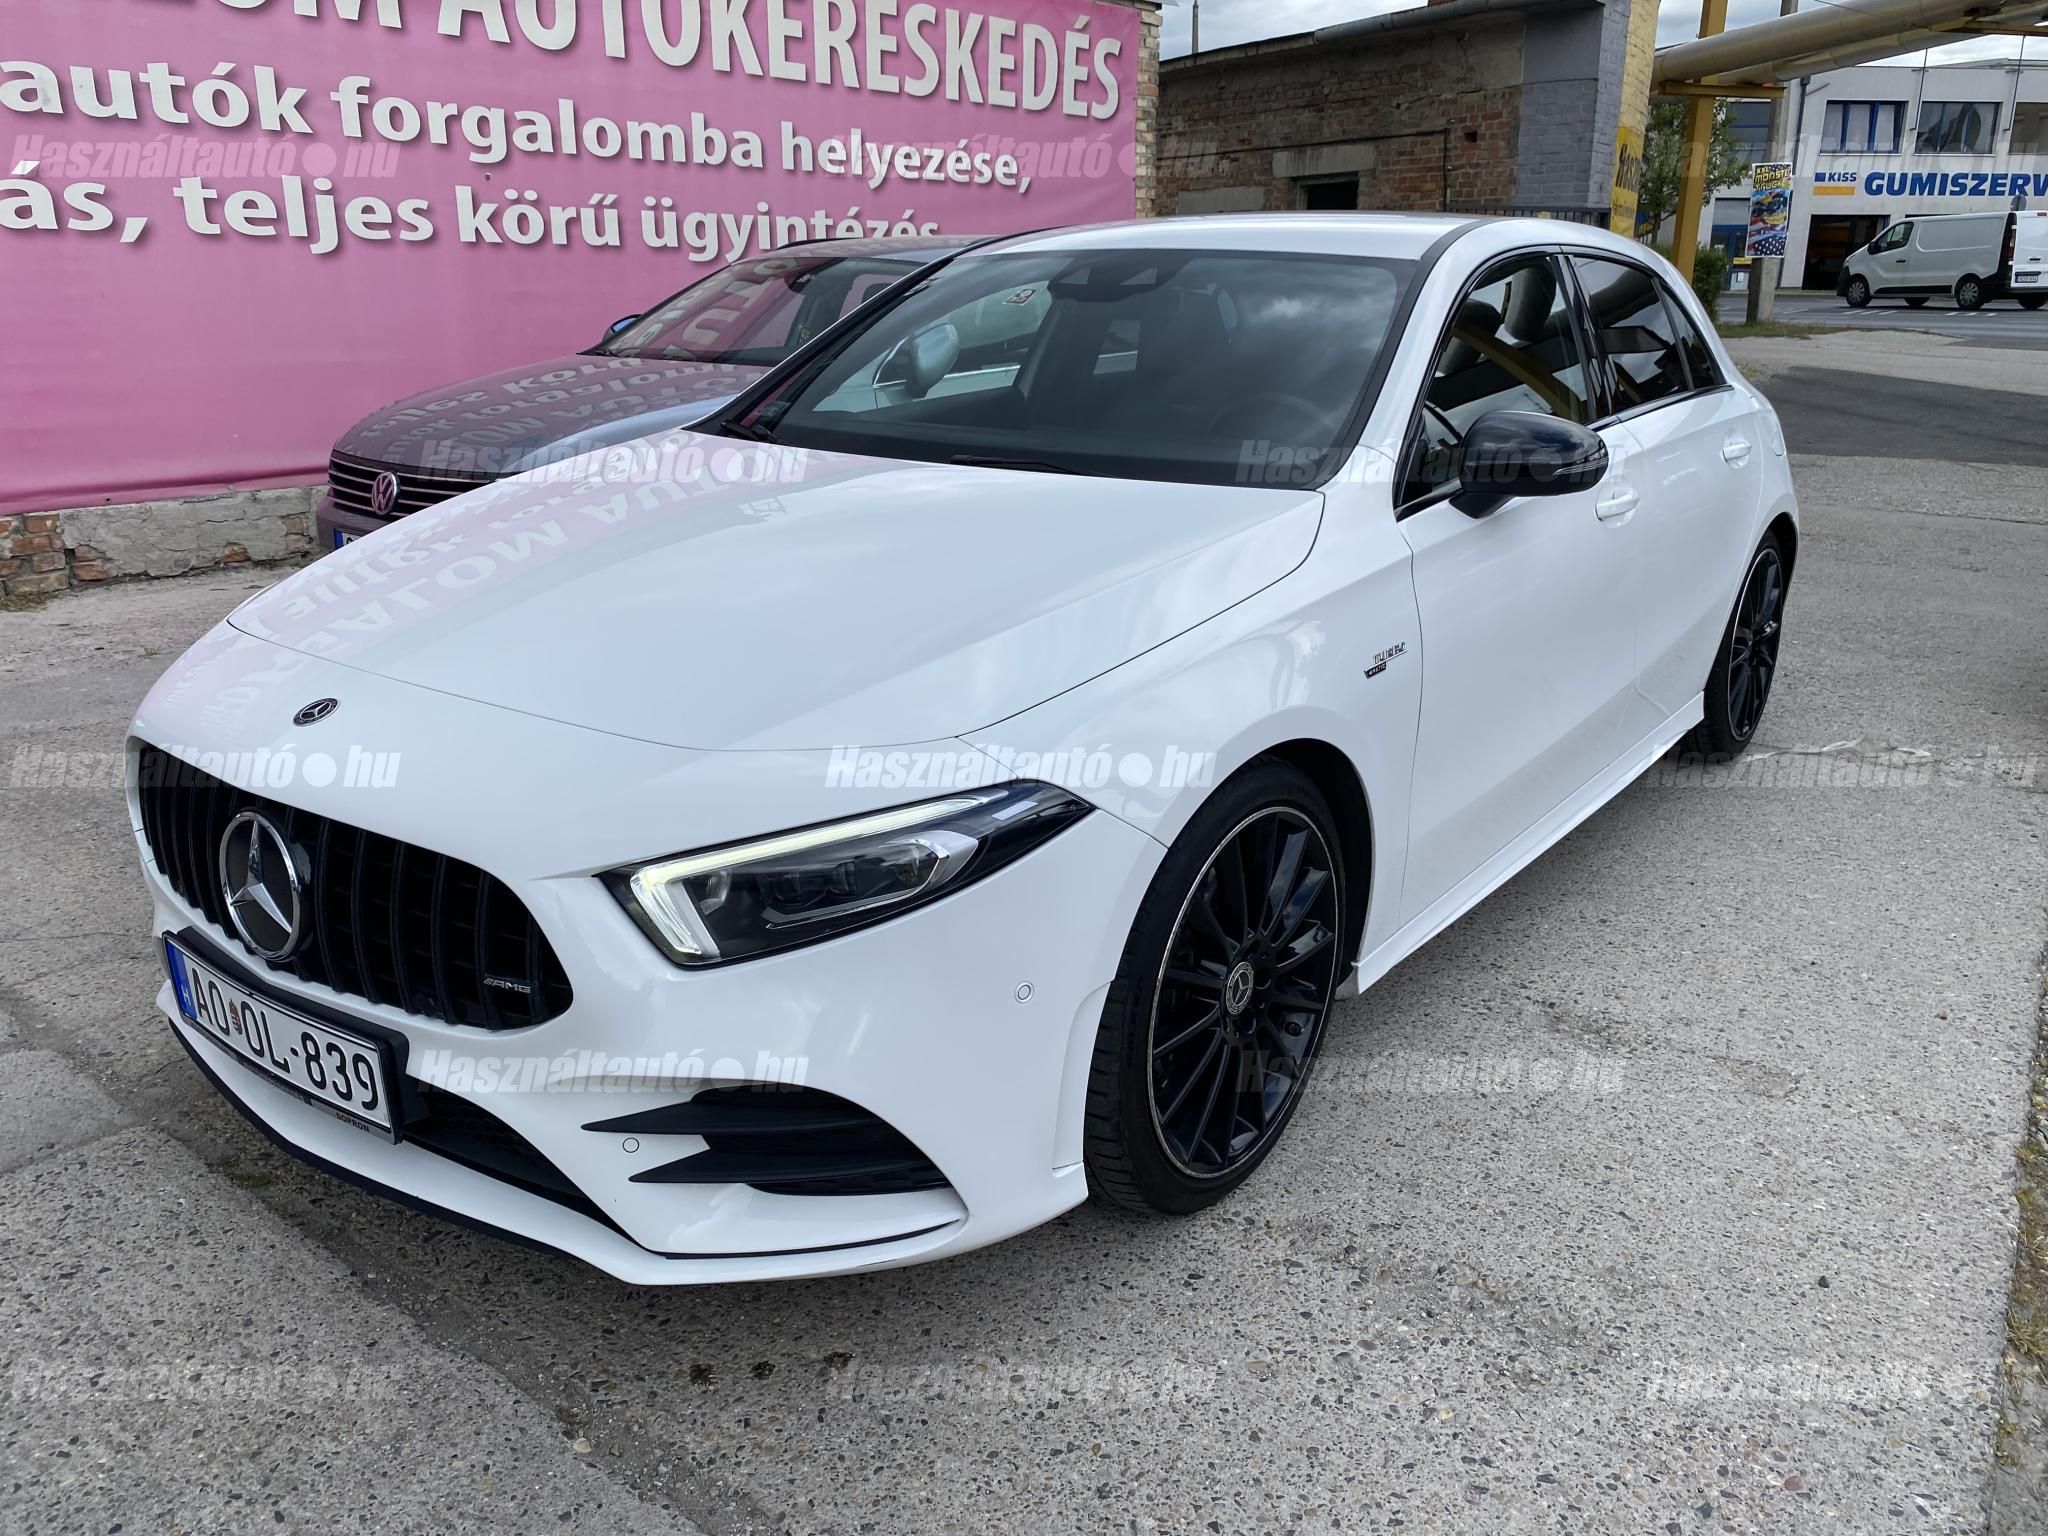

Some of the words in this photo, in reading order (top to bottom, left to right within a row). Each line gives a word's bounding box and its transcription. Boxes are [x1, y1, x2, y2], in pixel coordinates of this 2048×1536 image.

[0, 60, 313, 134] autók
[330, 75, 764, 168] forgalomba
[780, 121, 1031, 194] helyezése,
[1827, 172, 1857, 182] KISS
[173, 175, 434, 254] teljes
[454, 184, 621, 248] körű
[336, 1112, 370, 1133] SOPRON
